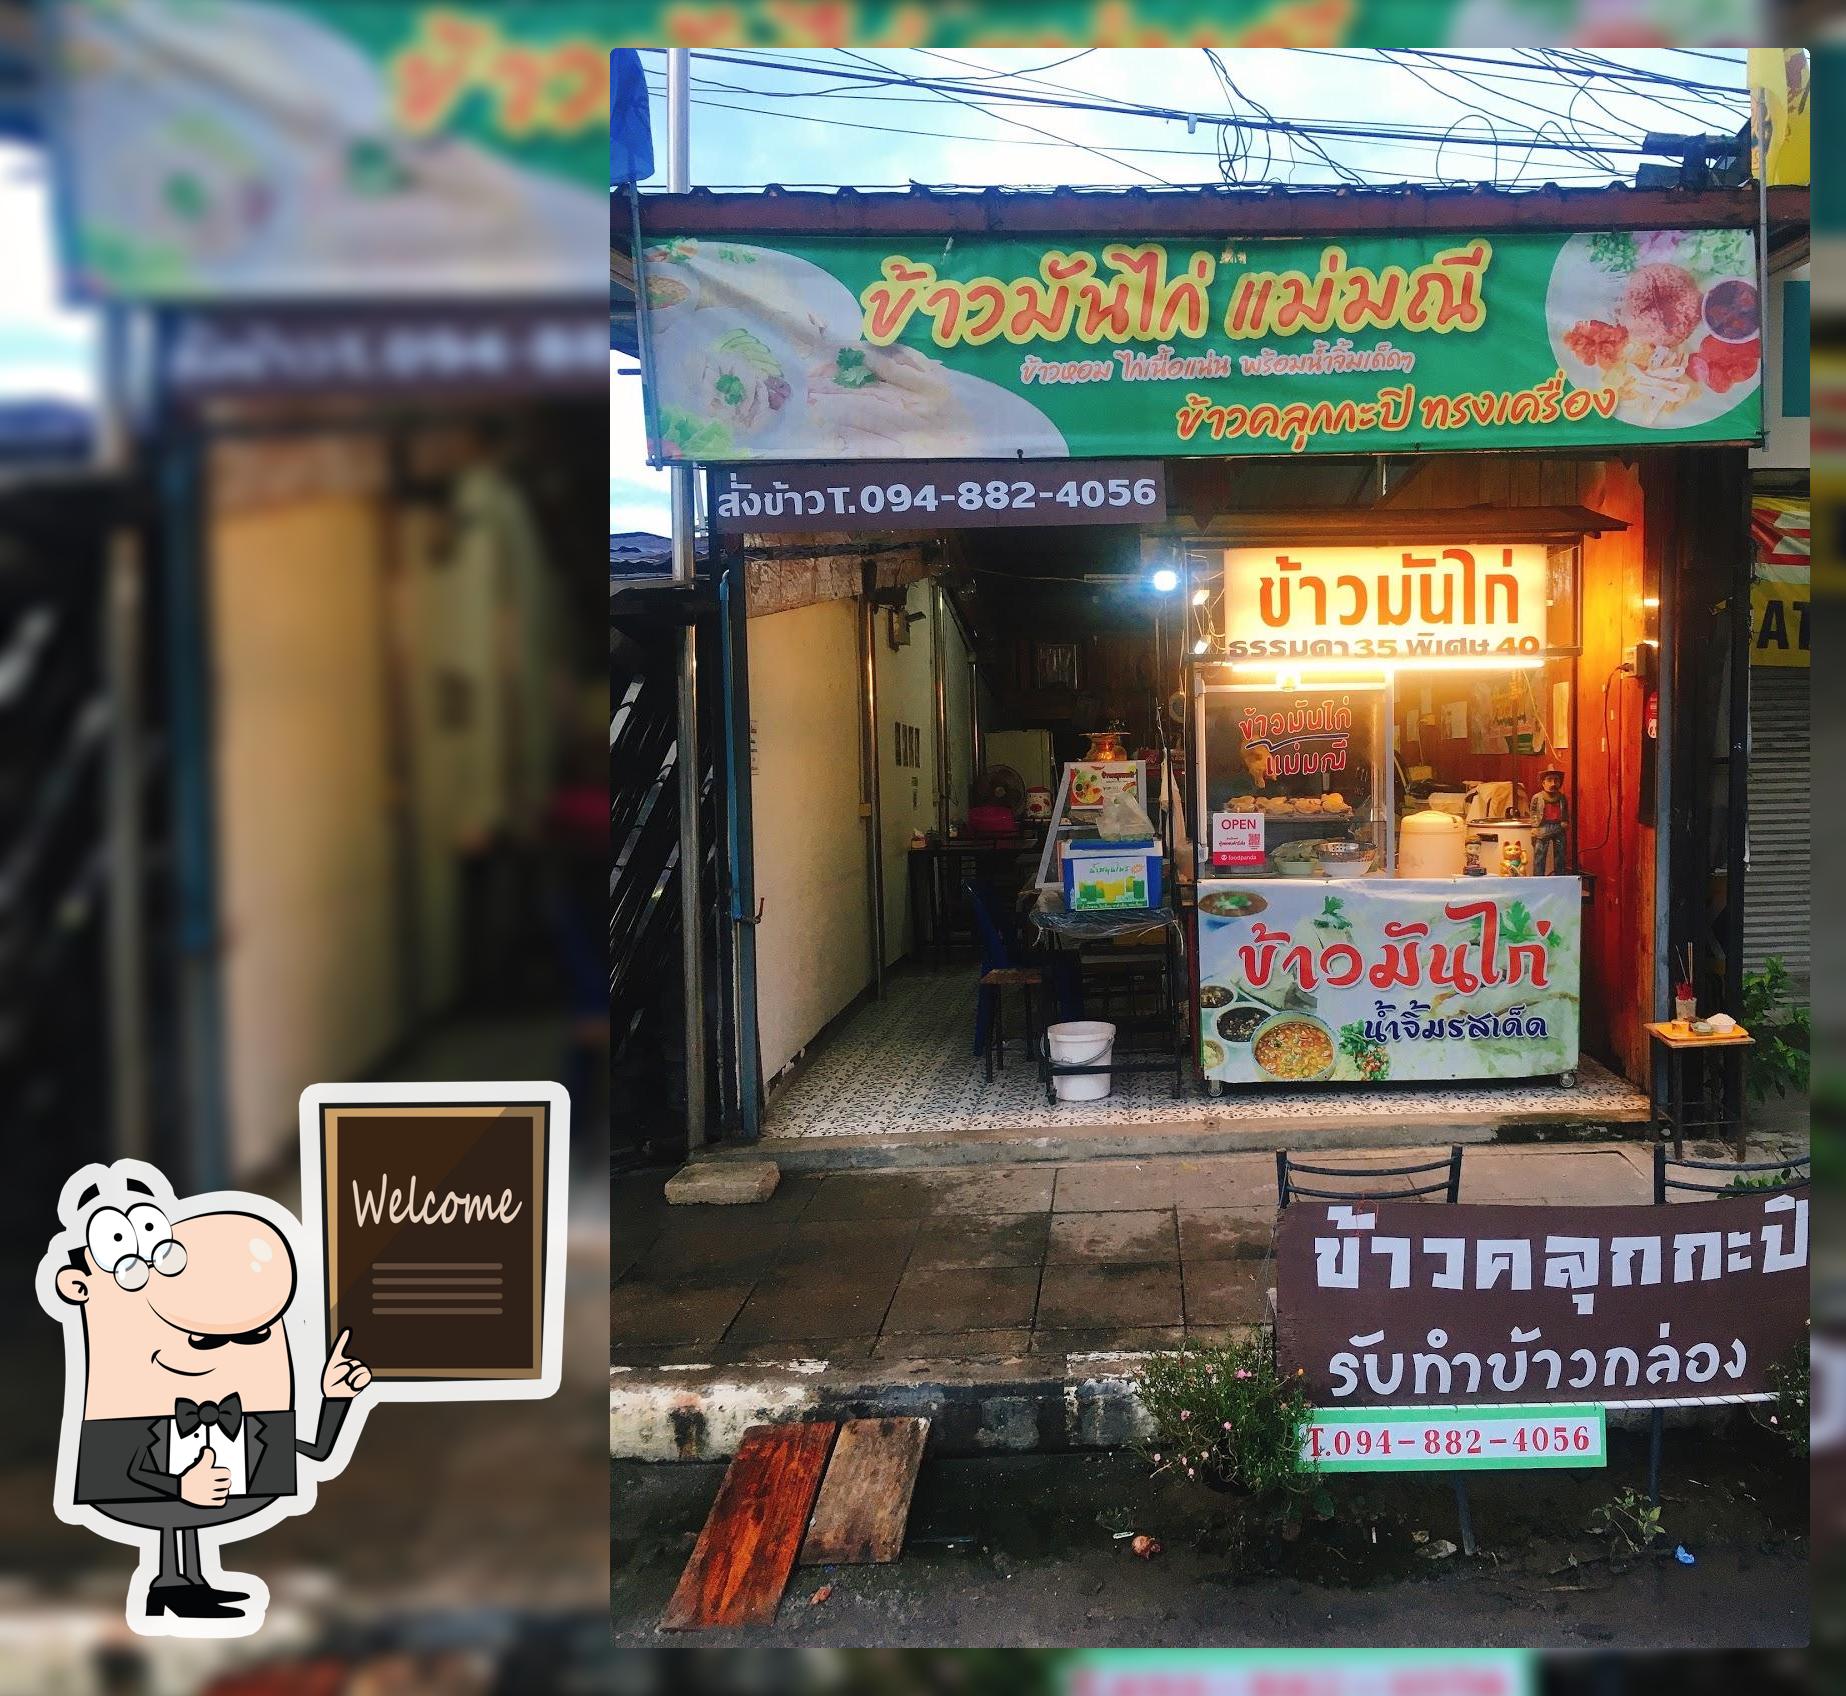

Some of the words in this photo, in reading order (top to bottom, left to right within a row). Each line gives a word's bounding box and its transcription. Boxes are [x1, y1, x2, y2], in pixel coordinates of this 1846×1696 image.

[864, 245, 1209, 345] ข้าวมันไก่
[1227, 240, 1485, 336] แม่มณี
[1021, 355, 1112, 384] ข้าวหอม
[1114, 345, 1230, 380] ไก่เนื้อแน่น
[1176, 386, 1415, 451] ข้าวคลุกกะปิ
[1421, 371, 1617, 430] ทรงเครื่อง
[1259, 548, 1520, 628] ข้าวมันไก่
[1238, 695, 1351, 740] ข้าวมันไก่
[1266, 738, 1347, 776] แม่มณี
[1221, 818, 1257, 830] OPEN
[1237, 899, 1552, 996] ข้าวมันไก่
[1364, 999, 1549, 1043] น้ำจิ้มรสเด็ด
[1314, 1194, 1809, 1316] ข้าวคลุกกะปิ
[1328, 1321, 1747, 1398] รับทำข้าวกล่อง
